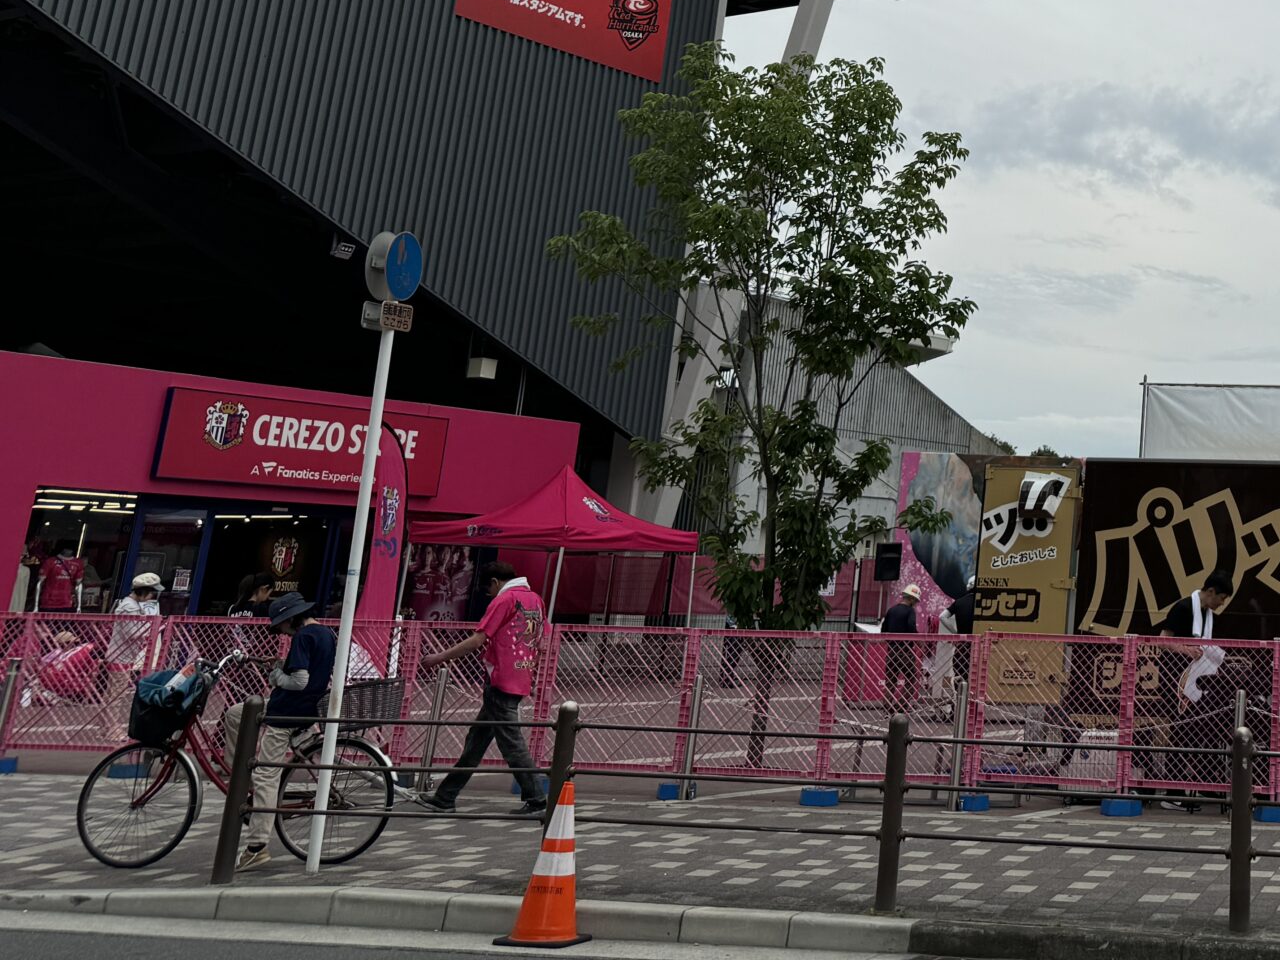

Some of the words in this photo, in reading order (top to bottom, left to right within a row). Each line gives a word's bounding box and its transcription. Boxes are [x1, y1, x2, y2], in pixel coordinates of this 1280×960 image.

[609, 6, 631, 20] Red
[608, 19, 659, 33] Hurricanes
[622, 30, 643, 38] OSAKA
[252, 414, 346, 453] CEREZO
[347, 424, 419, 459] SRE
[250, 465, 260, 476] A
[276, 465, 320, 481] Fanatics
[320, 470, 376, 484] Experie
[992, 547, 1057, 568] としたおいしさ
